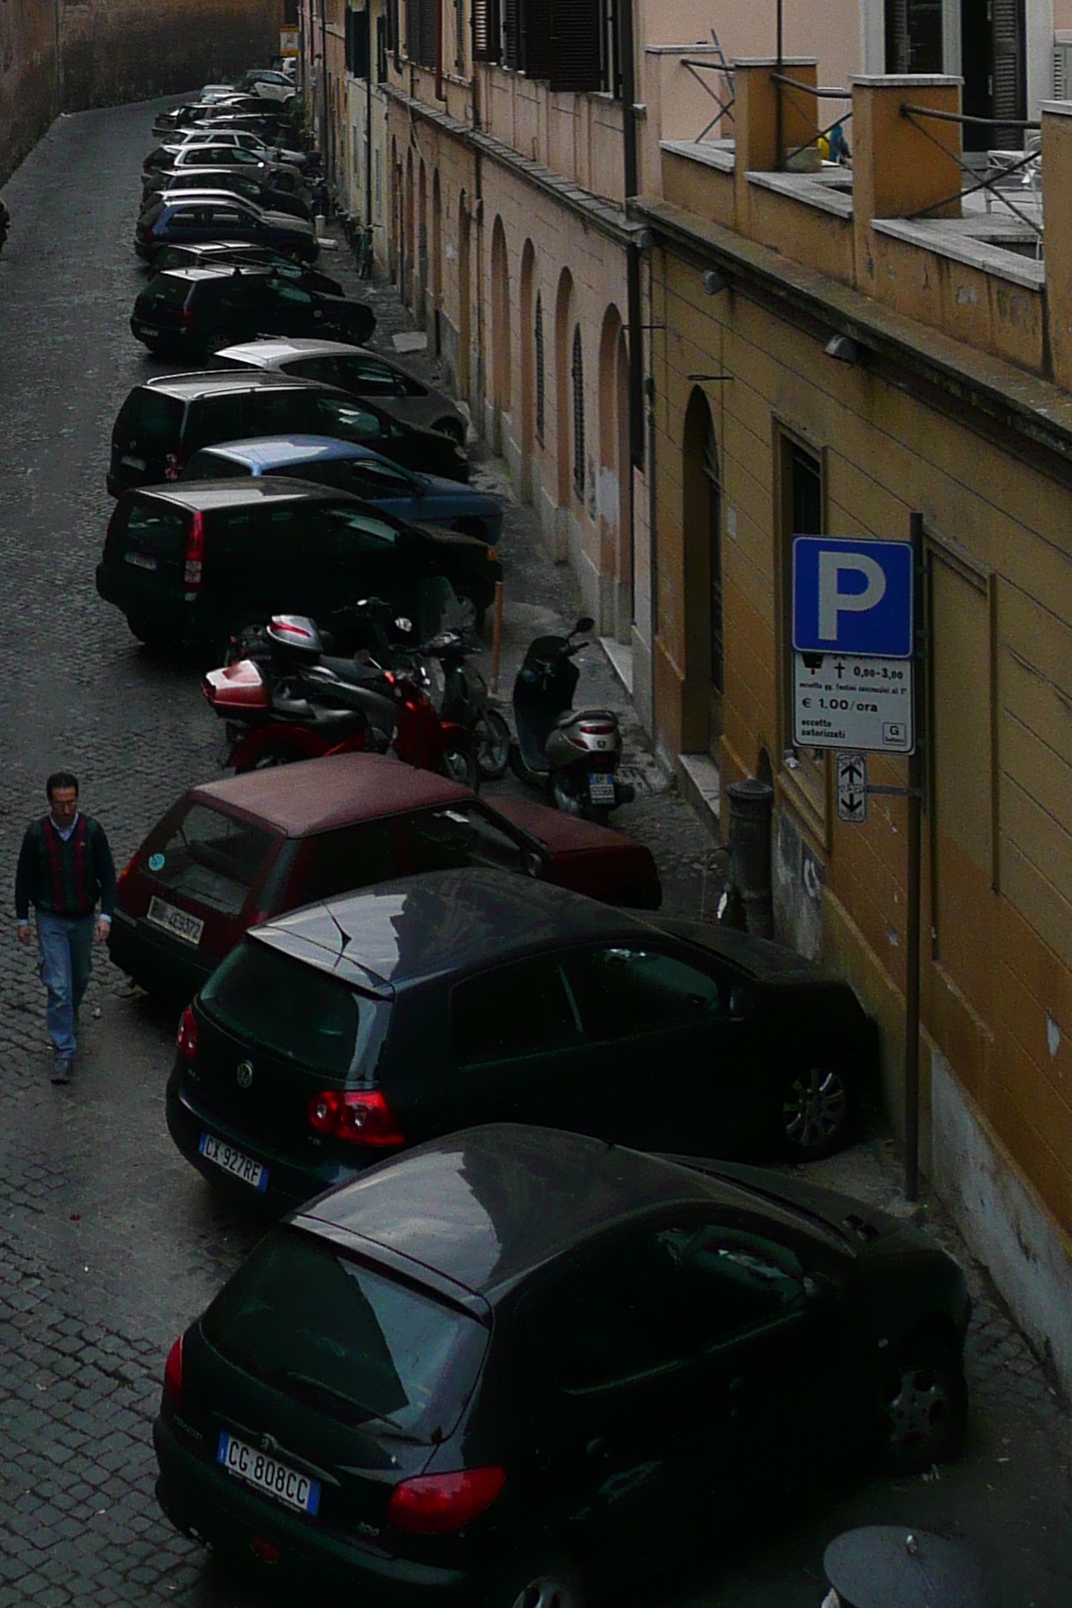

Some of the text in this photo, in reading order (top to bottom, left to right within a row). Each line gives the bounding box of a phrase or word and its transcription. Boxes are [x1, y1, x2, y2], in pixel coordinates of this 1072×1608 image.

[818, 551, 886, 641] P
[802, 697, 812, 709] €
[889, 725, 900, 736] G
